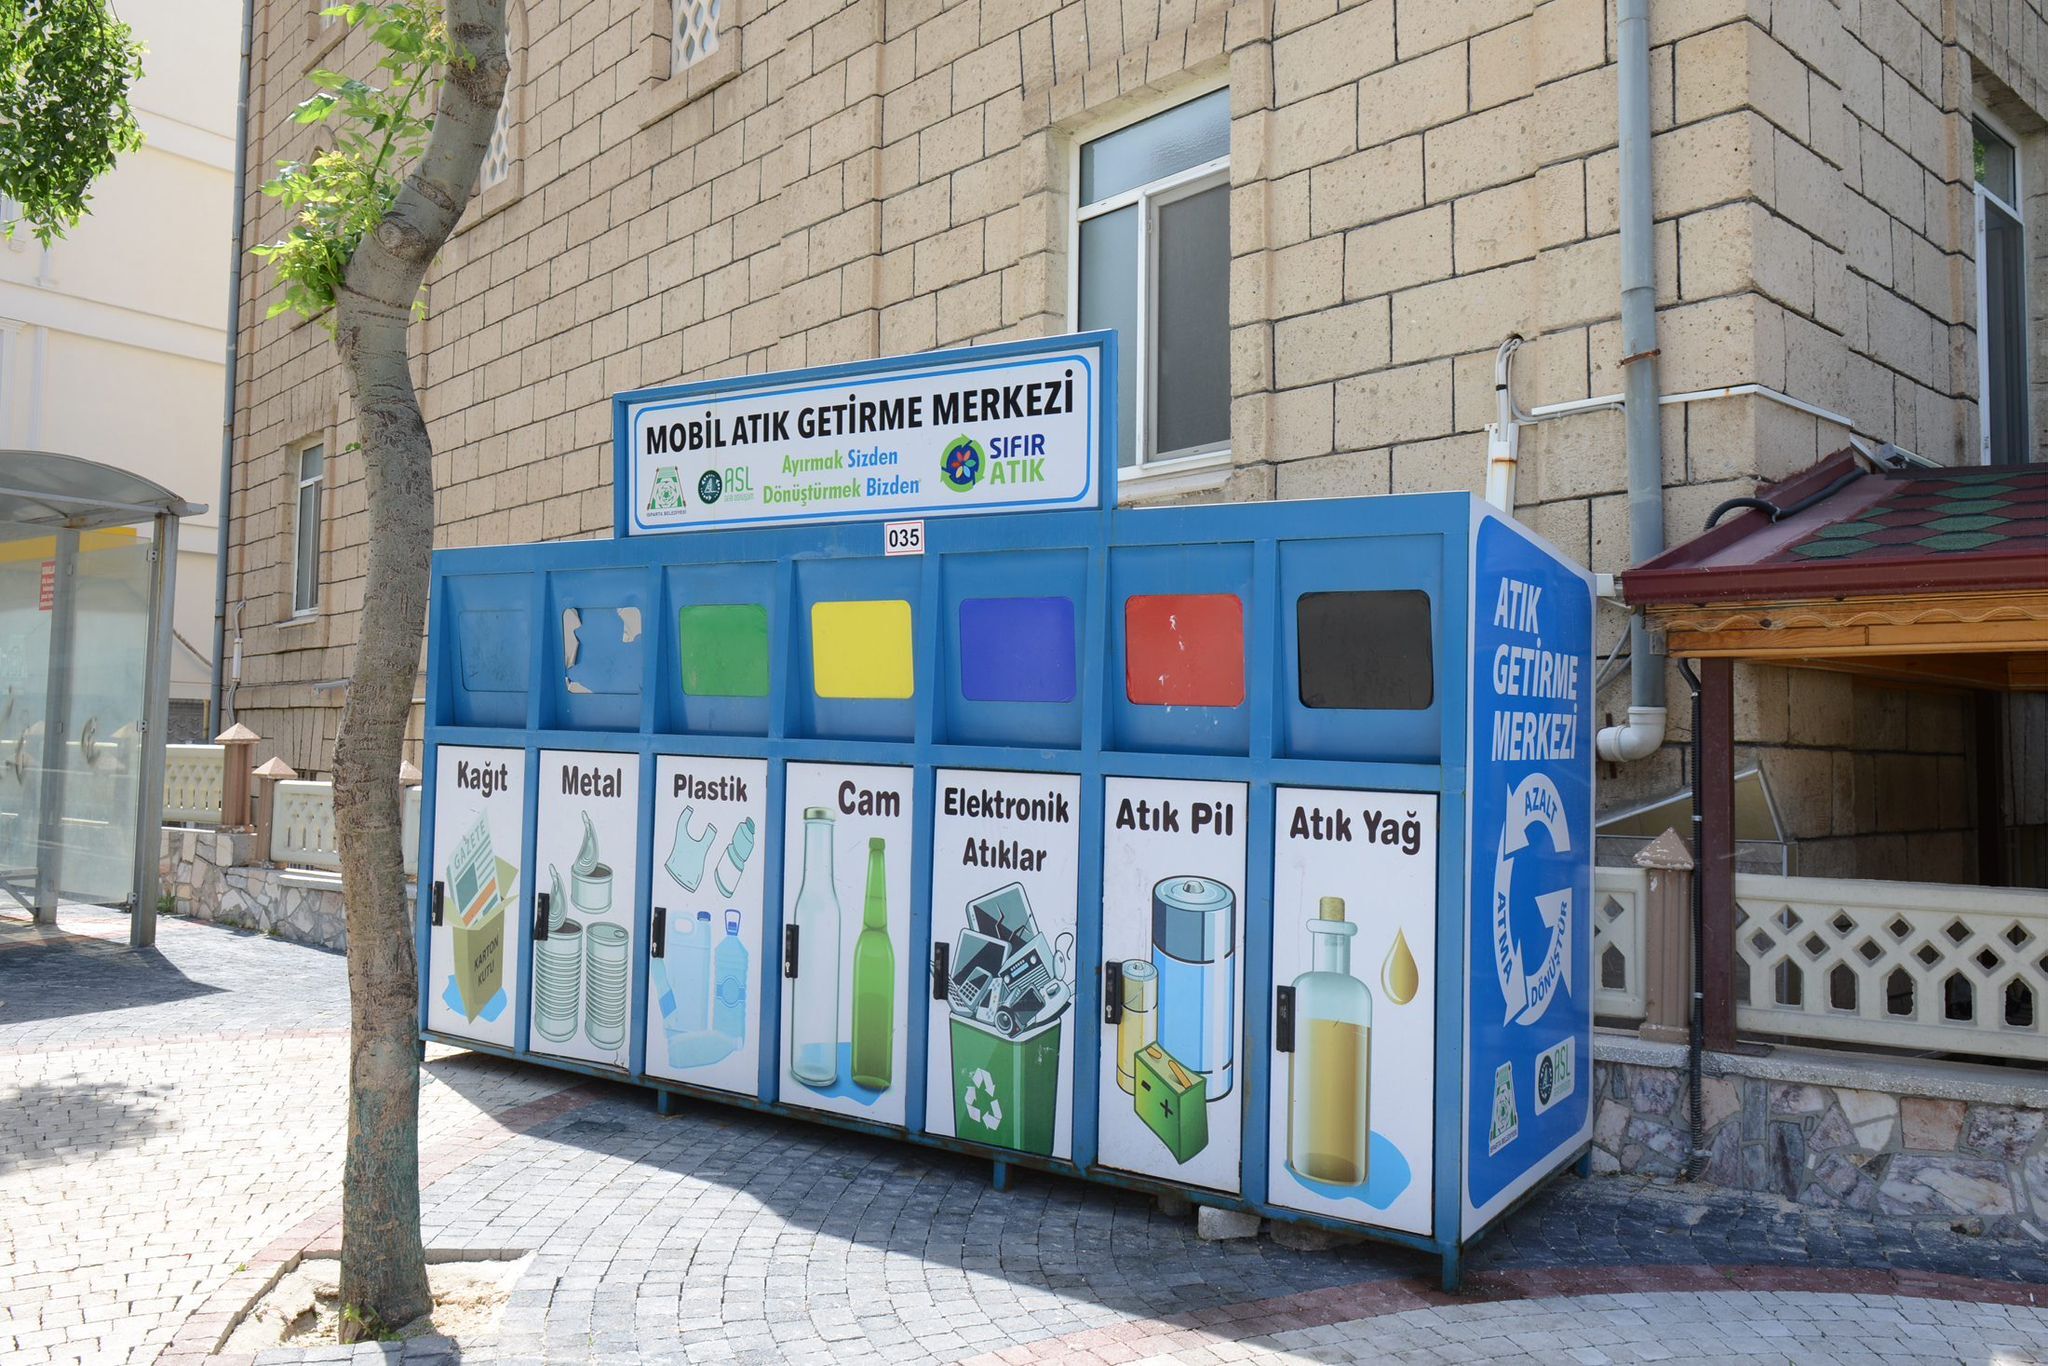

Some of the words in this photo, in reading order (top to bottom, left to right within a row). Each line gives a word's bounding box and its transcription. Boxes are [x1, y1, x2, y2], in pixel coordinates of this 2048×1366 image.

[646, 411, 727, 455] MOBİL
[731, 410, 790, 446] ATIK
[797, 393, 922, 439] GETİRME
[932, 368, 1074, 427] MERKEZİ
[782, 449, 843, 477] Ayırmak
[847, 445, 898, 468] Sizden
[989, 433, 1046, 460] SIFIR
[724, 466, 754, 493] ASL
[989, 457, 1045, 486] ATIK
[763, 482, 861, 506] Dönüştürmek
[866, 474, 920, 497] Bizden
[889, 528, 920, 548] 035
[1494, 577, 1543, 635] ATIK
[1493, 638, 1578, 700] GETİRME
[1491, 703, 1578, 762] MERKEZİ
[457, 761, 508, 798] Kağıt
[562, 765, 622, 798] Metal
[673, 773, 748, 803] Plastik
[838, 780, 900, 817] Cam
[944, 787, 1069, 823] Elektronik
[1525, 787, 1558, 823] AZALT
[1116, 798, 1179, 834] Atık
[1191, 802, 1233, 836] Pil
[1289, 806, 1352, 842] Atık
[1363, 810, 1421, 856] Yağ
[454, 820, 486, 870] GAZETE
[962, 837, 1047, 872] Atıklar
[474, 936, 499, 971] KARTON
[1497, 891, 1513, 985] ATMA
[478, 961, 495, 987] KUTU
[1554, 1044, 1570, 1084] ASL
